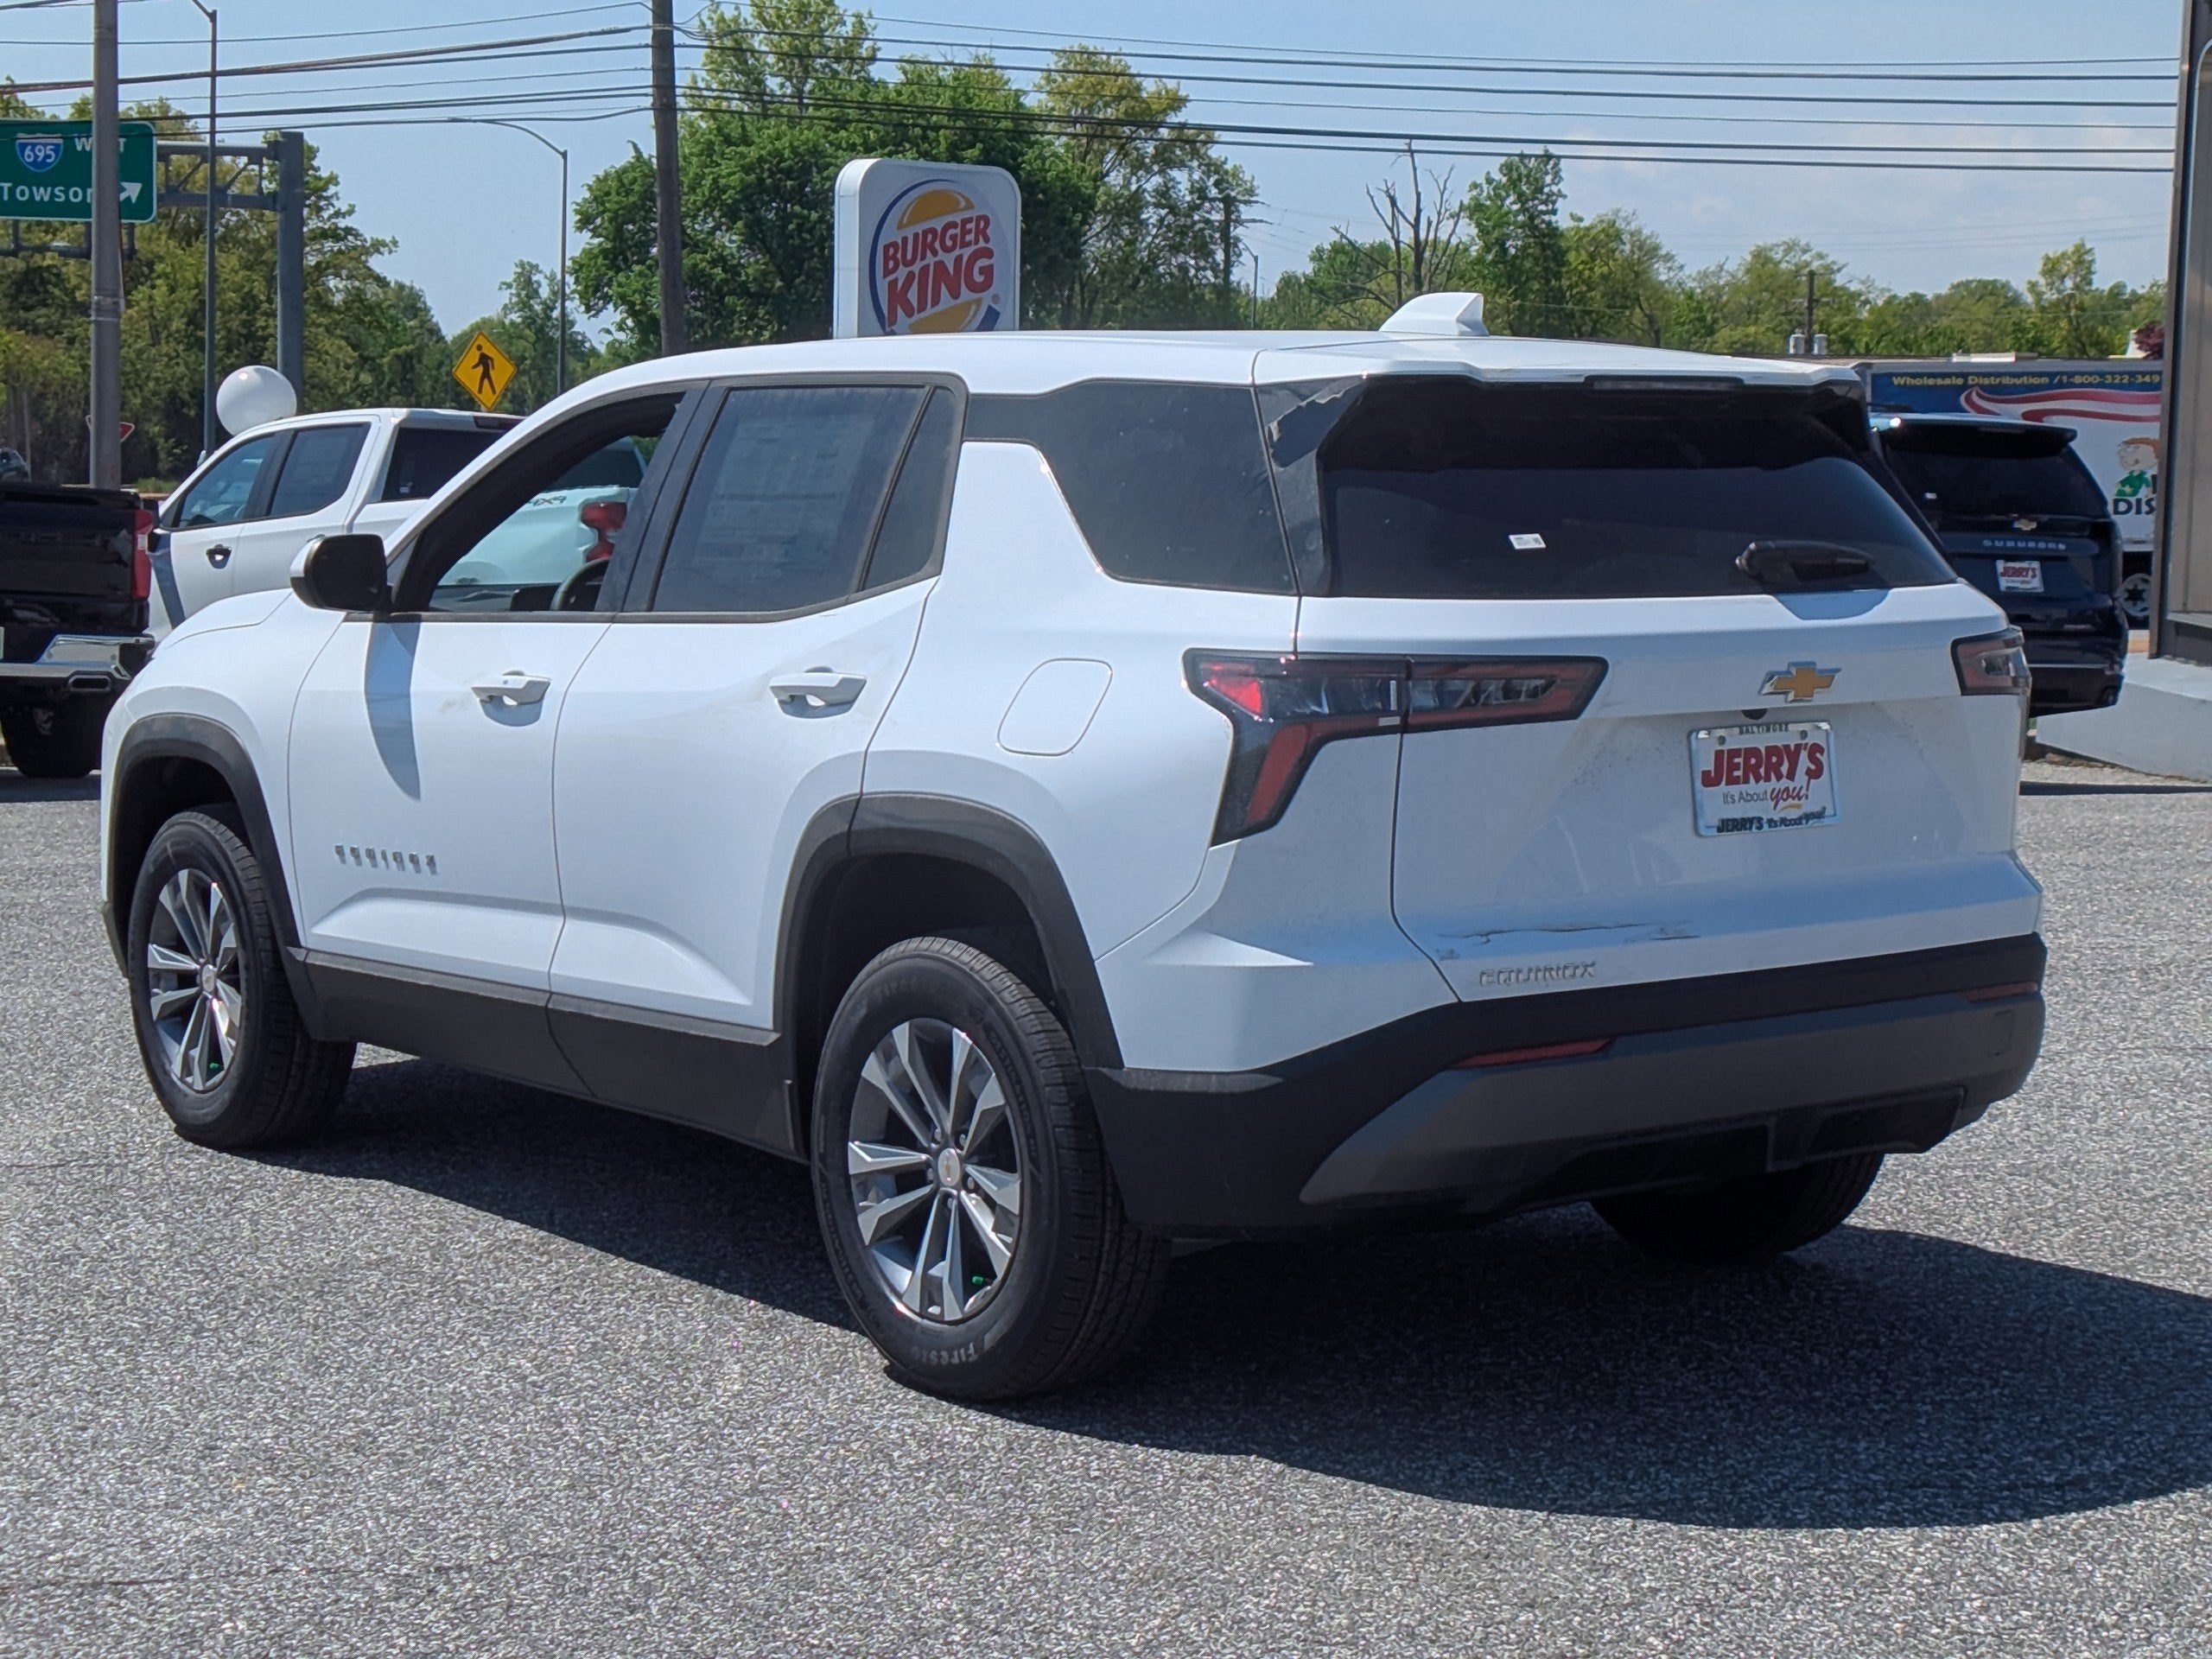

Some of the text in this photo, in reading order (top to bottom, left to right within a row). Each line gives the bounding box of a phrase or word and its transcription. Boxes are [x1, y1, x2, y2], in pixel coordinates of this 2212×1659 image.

[23, 137, 126, 162] 695 WT
[882, 213, 991, 279] BURGER
[887, 246, 995, 328] KING
[1892, 376, 1964, 385] Wholesale
[1967, 375, 2050, 385] Distribution
[1701, 742, 1826, 788] JERRY'S
[1722, 791, 1736, 805] It's
[1738, 790, 1768, 803] About
[1479, 960, 1597, 988] EQUINOX
